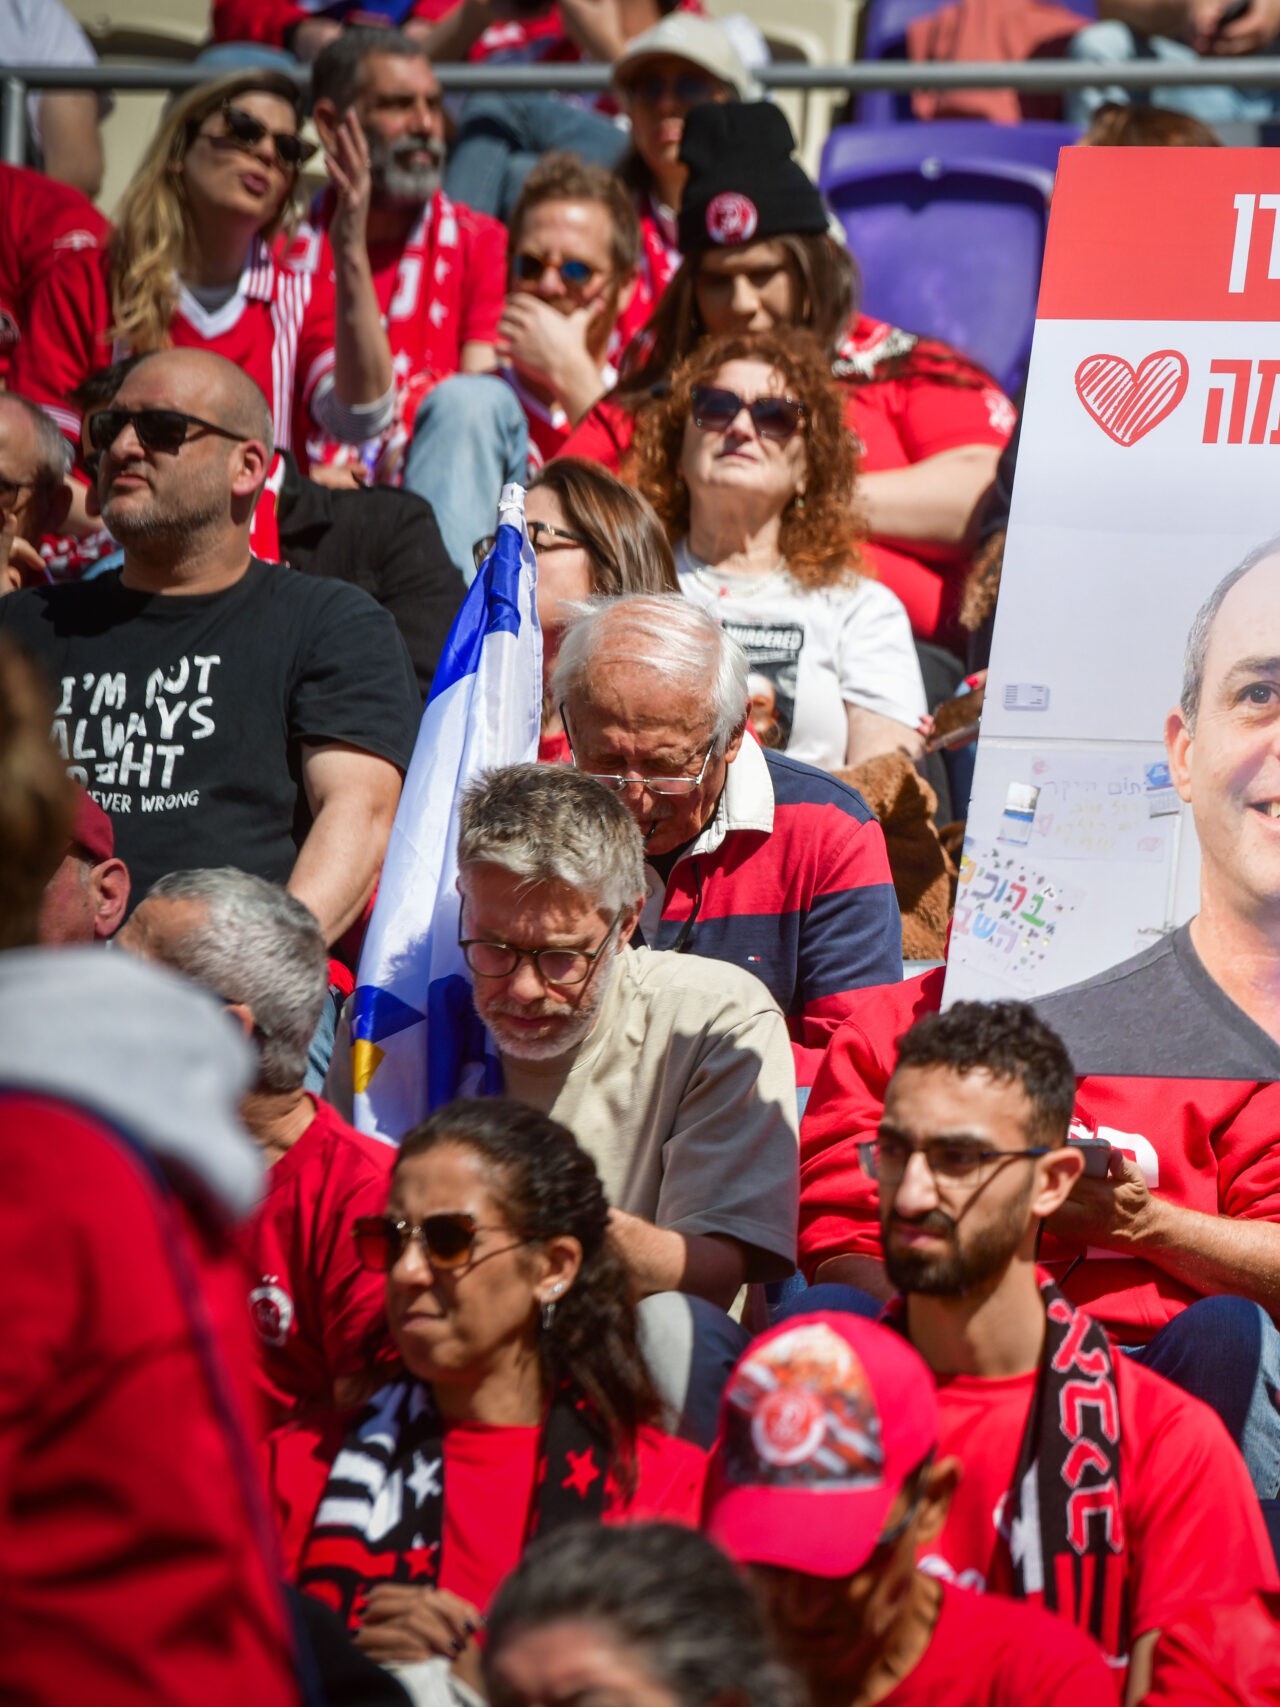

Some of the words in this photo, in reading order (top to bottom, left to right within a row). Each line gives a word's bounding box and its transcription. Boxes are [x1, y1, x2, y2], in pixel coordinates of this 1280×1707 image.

[54, 671, 127, 715] I'M
[87, 789, 132, 814] EVER
[140, 788, 201, 814] WRONG
